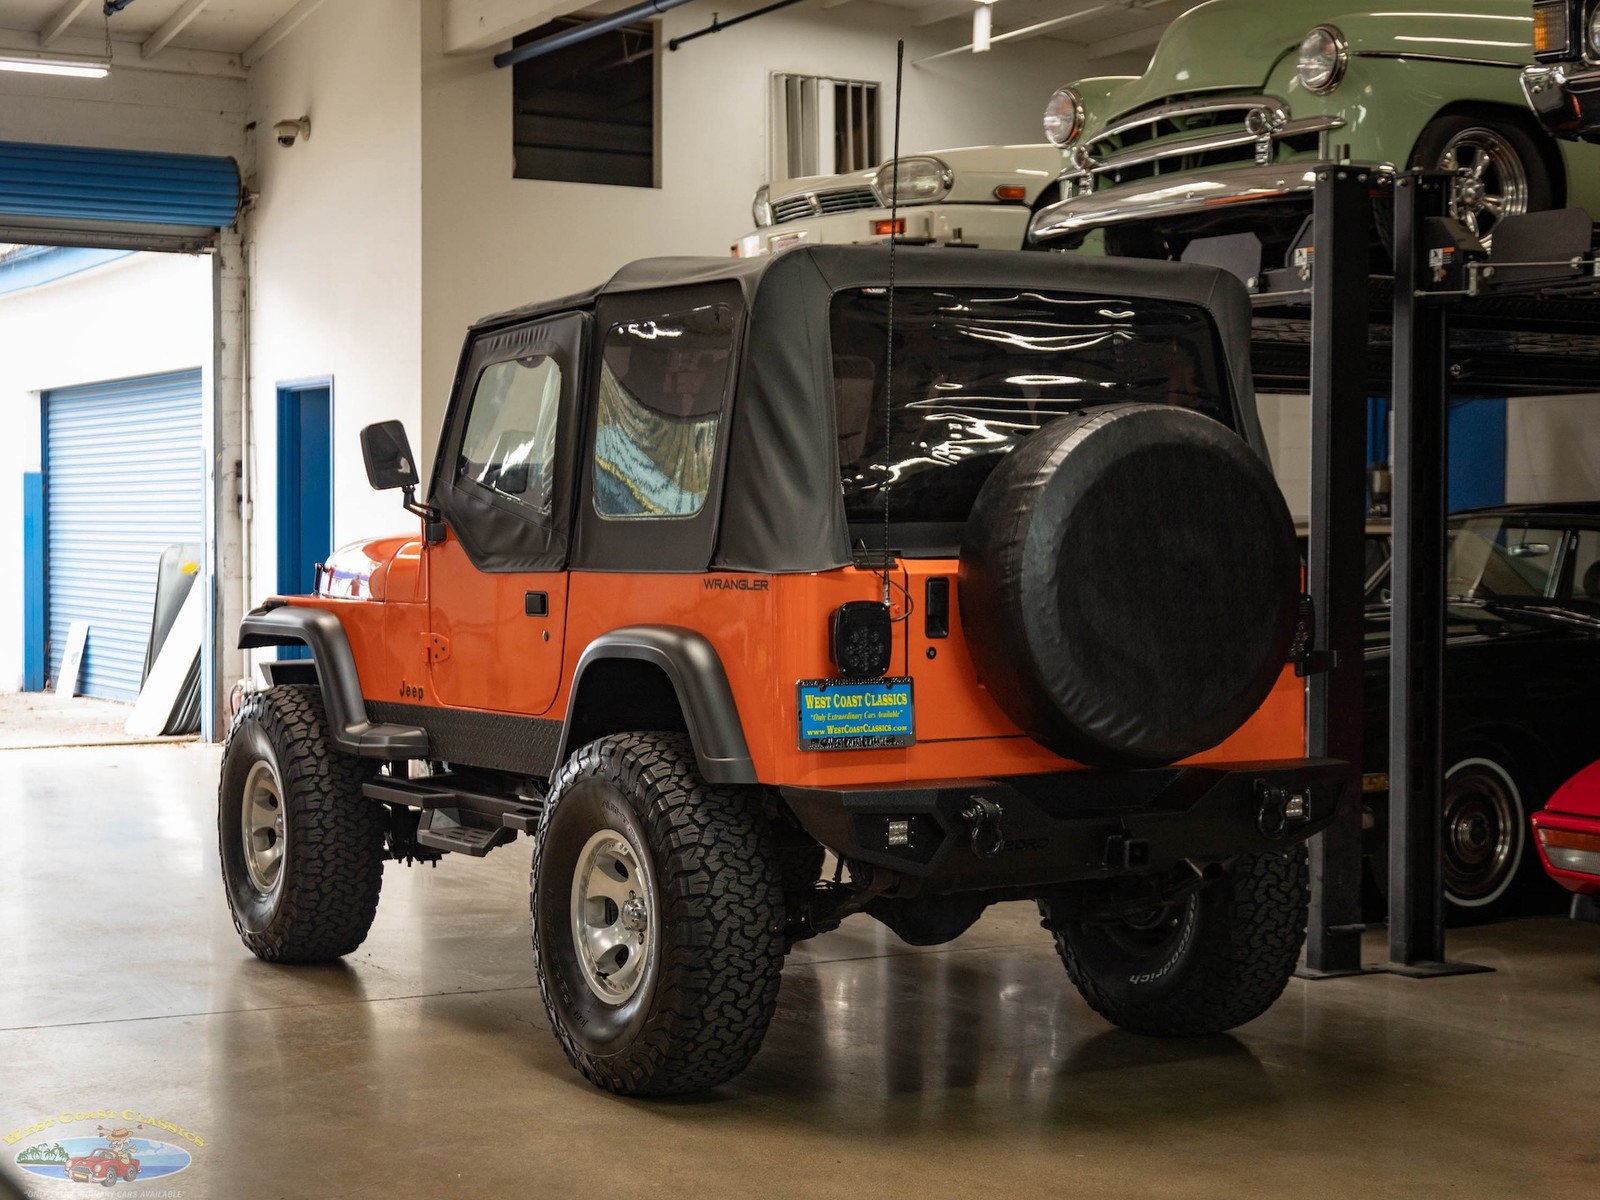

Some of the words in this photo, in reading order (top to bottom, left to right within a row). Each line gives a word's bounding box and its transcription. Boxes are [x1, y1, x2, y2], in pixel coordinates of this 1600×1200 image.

[703, 578, 769, 591] WRANGLER
[399, 680, 424, 701] Jeep
[804, 694, 832, 709] WEST
[833, 693, 862, 708] COAST
[864, 692, 908, 707] CLASSICS
